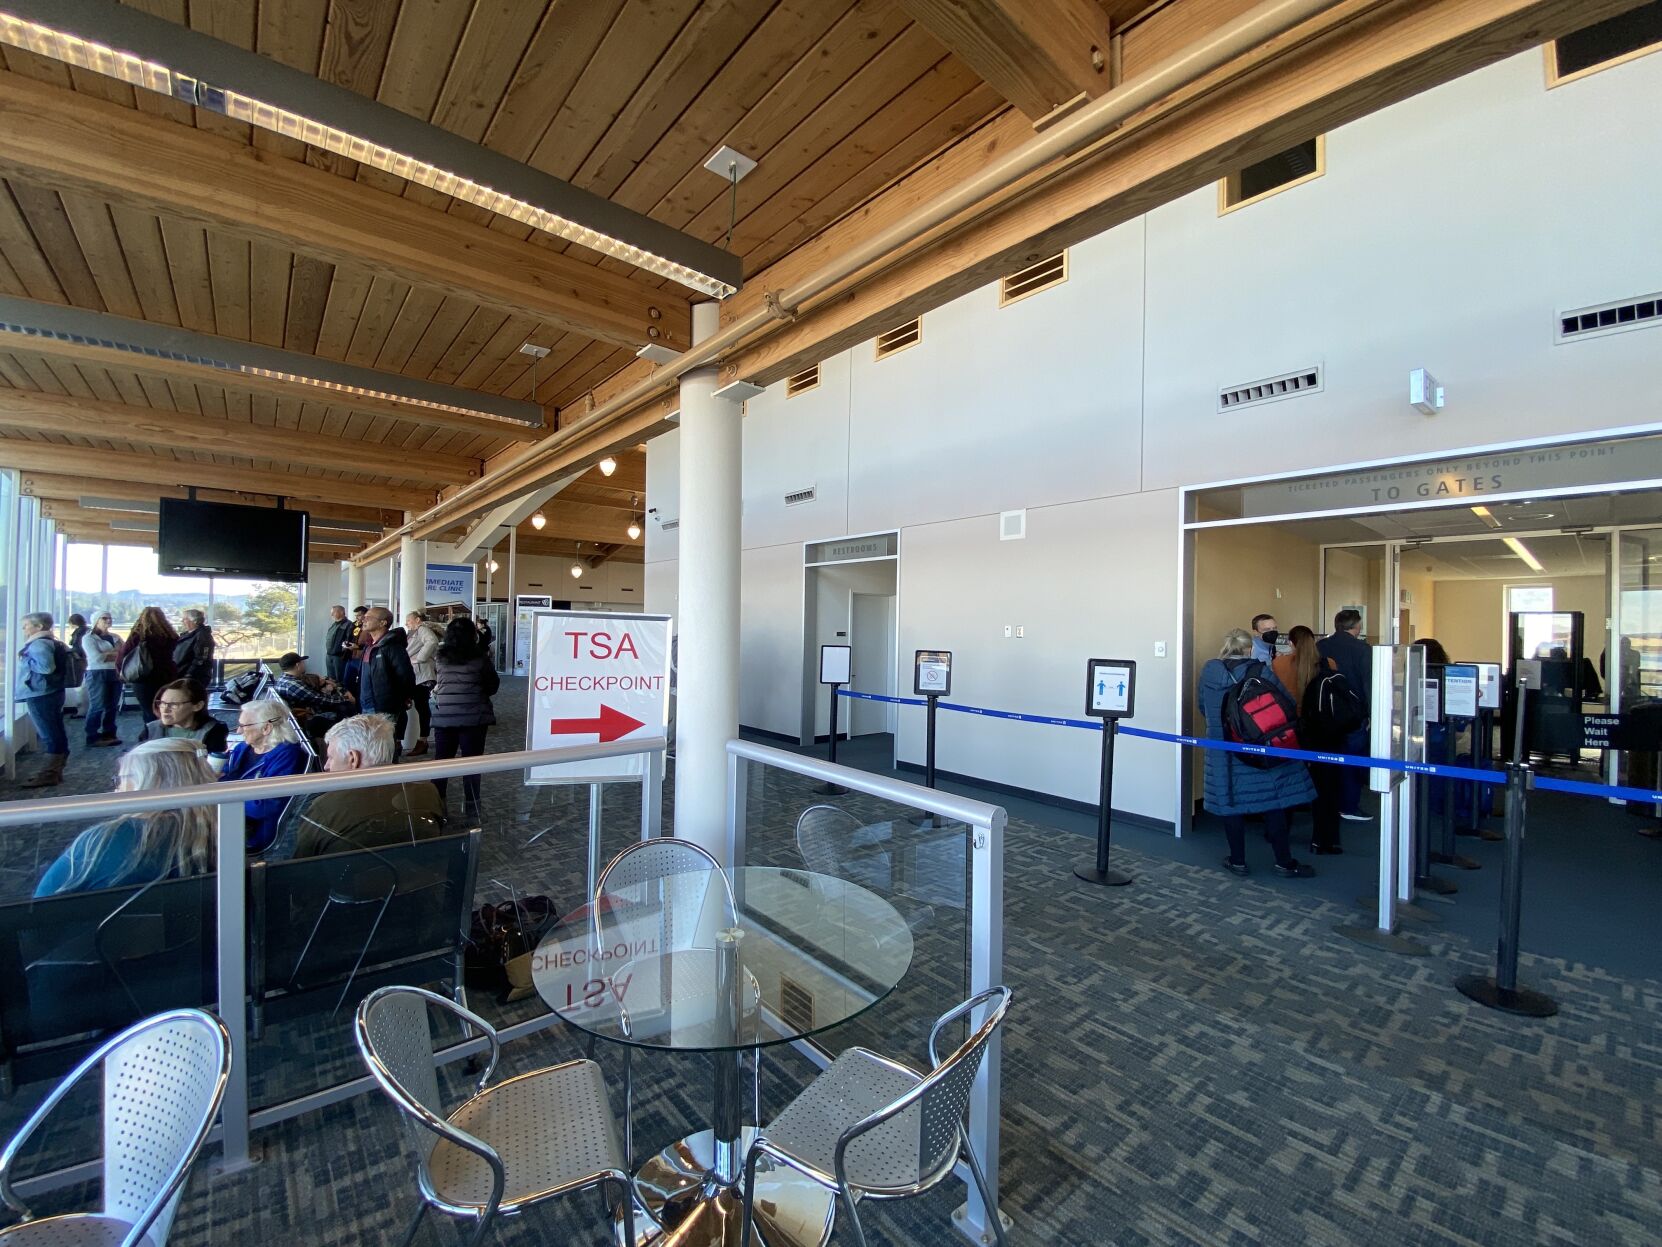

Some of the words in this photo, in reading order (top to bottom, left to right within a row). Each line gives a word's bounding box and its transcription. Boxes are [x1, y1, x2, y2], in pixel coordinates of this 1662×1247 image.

[1288, 480, 1338, 493] TICKETED
[1344, 469, 1420, 486] PASSENGERS
[1426, 464, 1459, 476] ONLY
[1466, 457, 1521, 471] BEYOND
[1530, 452, 1561, 464] THIS
[1570, 446, 1616, 459] POINT
[1371, 486, 1400, 501] TO
[1416, 474, 1503, 497] GATES
[425, 578, 465, 587] MEDIATE
[564, 631, 640, 660] TSA
[534, 675, 665, 692] CHECKPOINT
[1584, 716, 1620, 725] Please
[1584, 727, 1608, 736] Wait
[1584, 738, 1610, 747] Here
